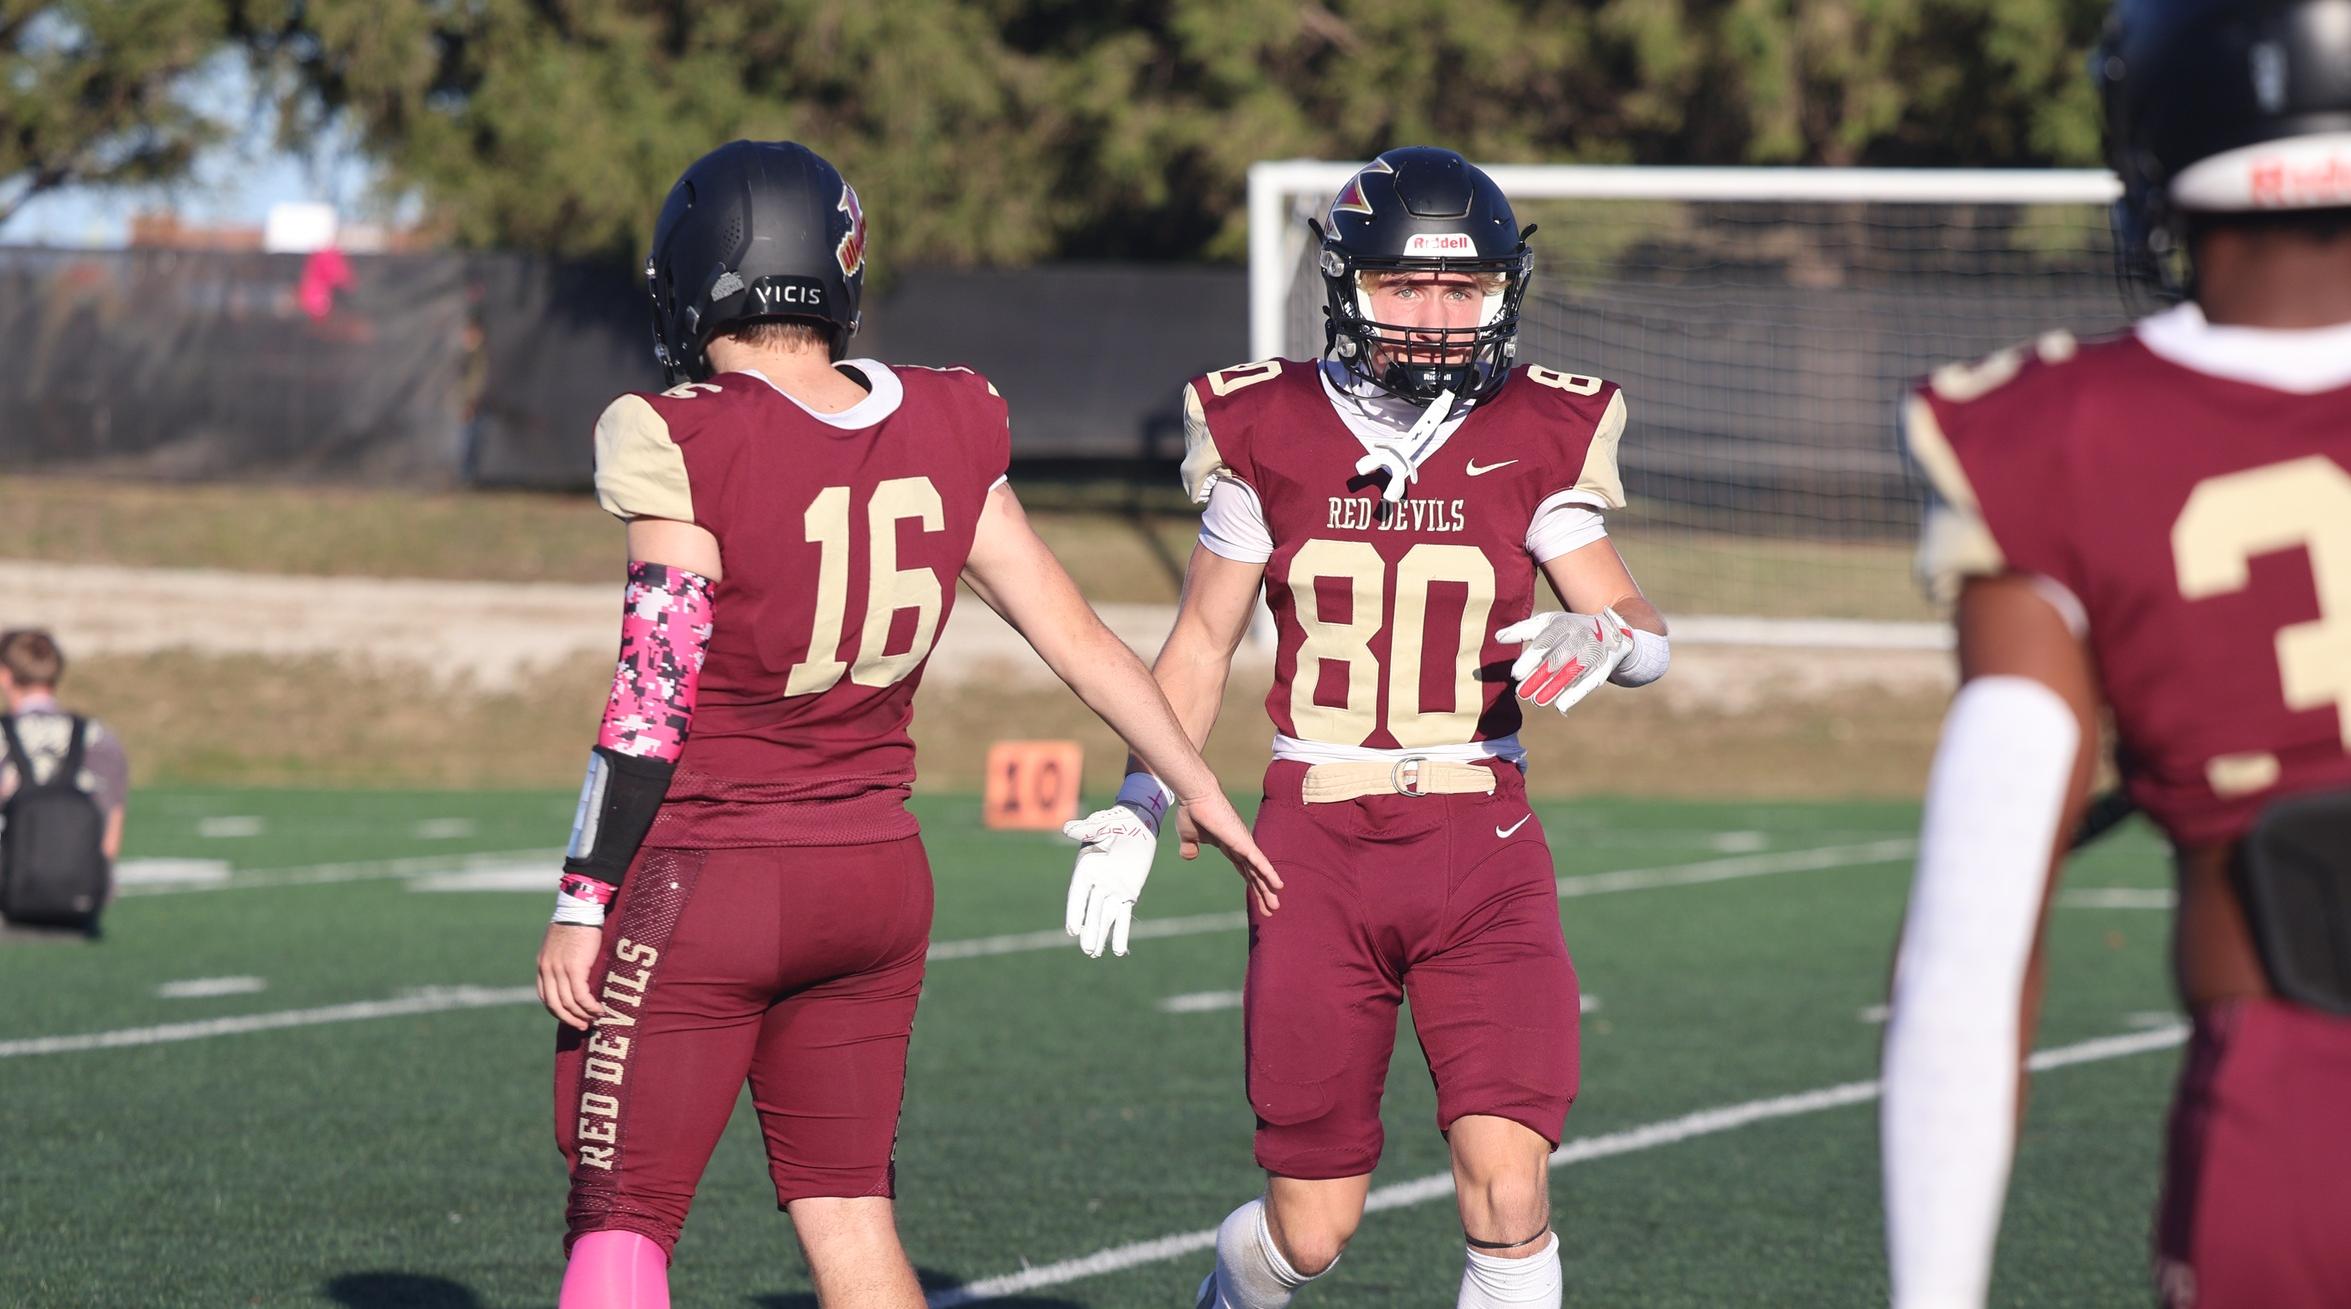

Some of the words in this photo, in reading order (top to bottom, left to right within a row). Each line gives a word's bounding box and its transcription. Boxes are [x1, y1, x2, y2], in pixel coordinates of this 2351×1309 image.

[755, 285, 821, 305] VICIS
[1326, 497, 1372, 530] RED
[1377, 498, 1465, 532] DEVILS
[784, 476, 945, 697] 16
[1287, 538, 1496, 749] 80
[1001, 761, 1062, 815] 10
[585, 937, 659, 1086] DEVILS
[578, 1090, 620, 1172] RED
